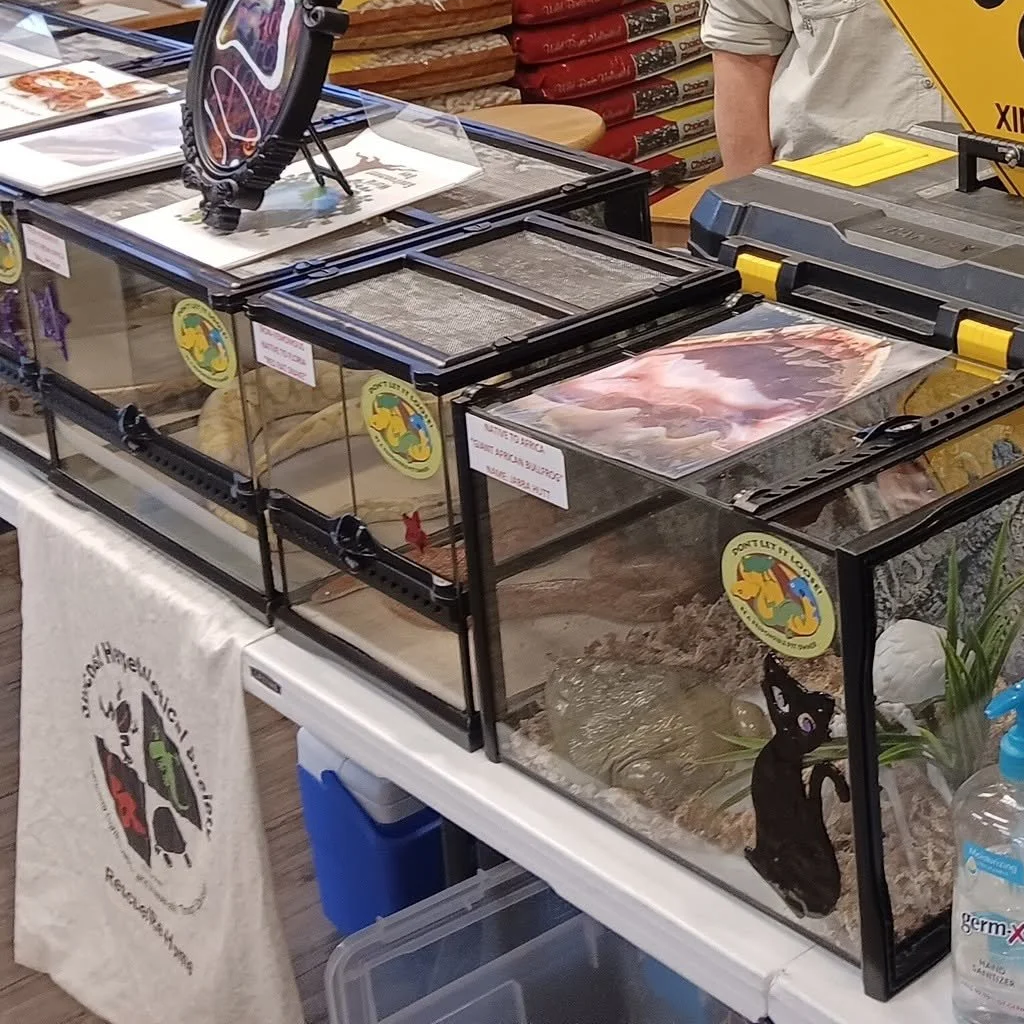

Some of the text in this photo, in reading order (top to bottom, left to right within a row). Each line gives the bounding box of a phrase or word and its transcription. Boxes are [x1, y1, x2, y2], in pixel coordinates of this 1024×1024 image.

[673, 0, 699, 13] Choice
[682, 79, 709, 93] Choice
[684, 118, 709, 133] Choice
[690, 155, 716, 170] Choice
